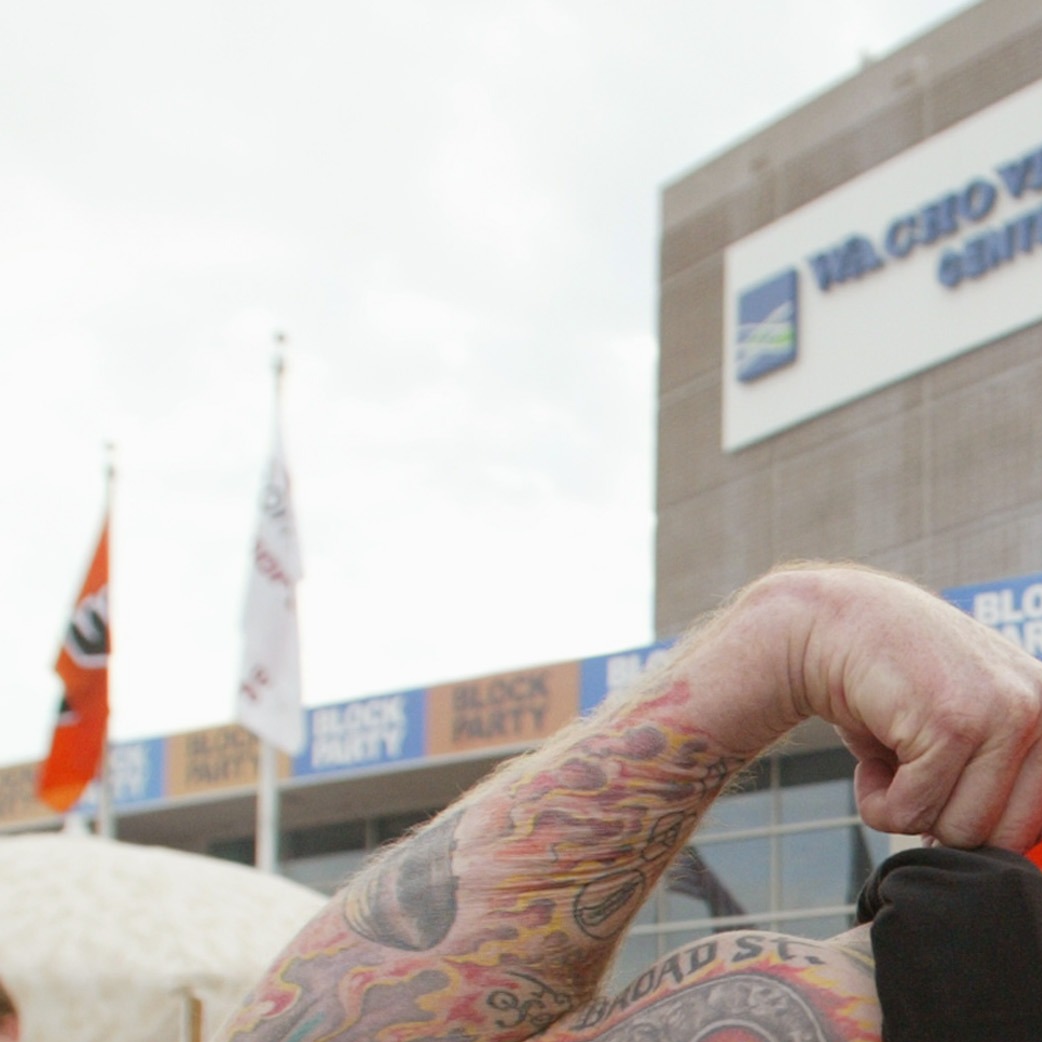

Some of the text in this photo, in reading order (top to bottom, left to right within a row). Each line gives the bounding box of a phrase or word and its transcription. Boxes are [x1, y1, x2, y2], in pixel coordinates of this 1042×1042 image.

[452, 670, 549, 706] BLOCK
[311, 698, 407, 734] BLOCK
[452, 706, 547, 742] PARTY
[311, 728, 405, 769] PARTY
